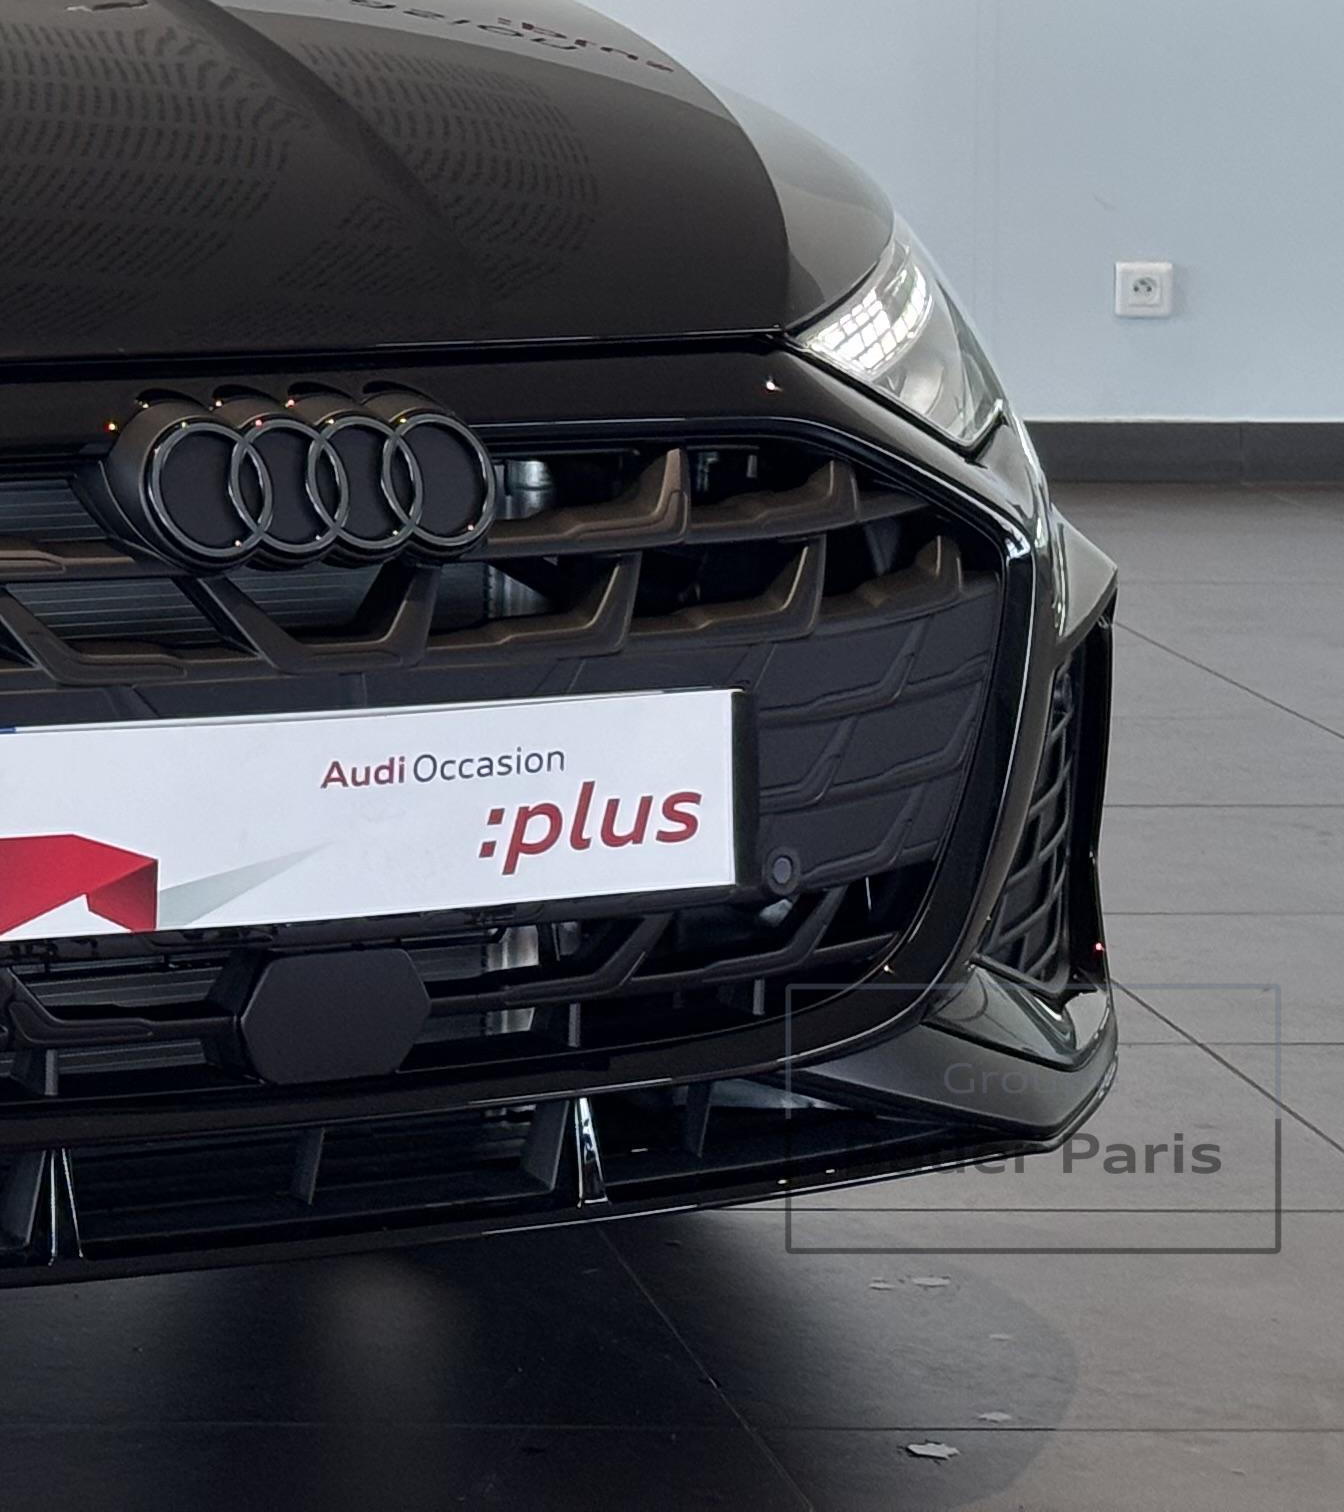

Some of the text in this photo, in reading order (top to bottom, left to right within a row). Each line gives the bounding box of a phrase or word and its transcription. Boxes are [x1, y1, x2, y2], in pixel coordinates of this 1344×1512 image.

[320, 745, 566, 789] Audi Occasion
[478, 780, 703, 876] :plus
